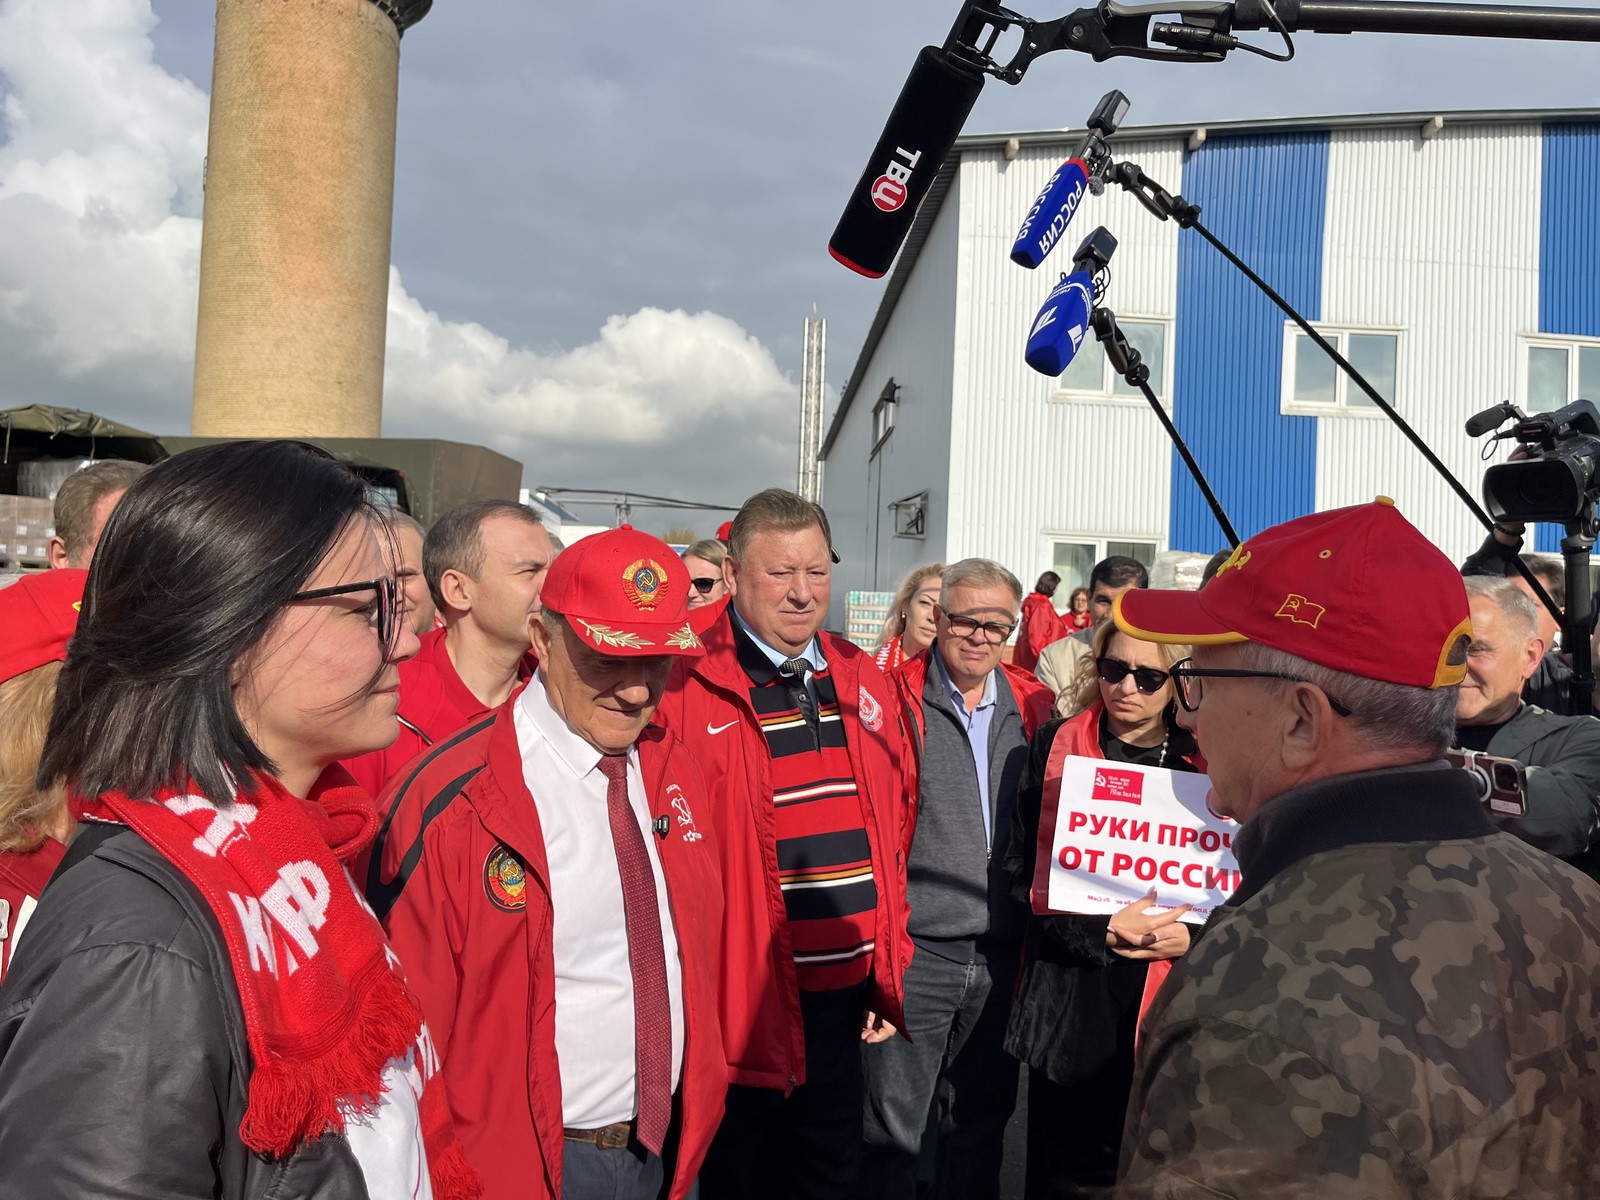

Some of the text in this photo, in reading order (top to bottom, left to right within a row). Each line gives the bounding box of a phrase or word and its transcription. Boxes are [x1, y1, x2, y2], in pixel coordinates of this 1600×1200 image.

[1038, 180, 1082, 255] РОССИЯ
[1068, 811, 1151, 843] РУКИ
[1058, 846, 1105, 874] ОТ
